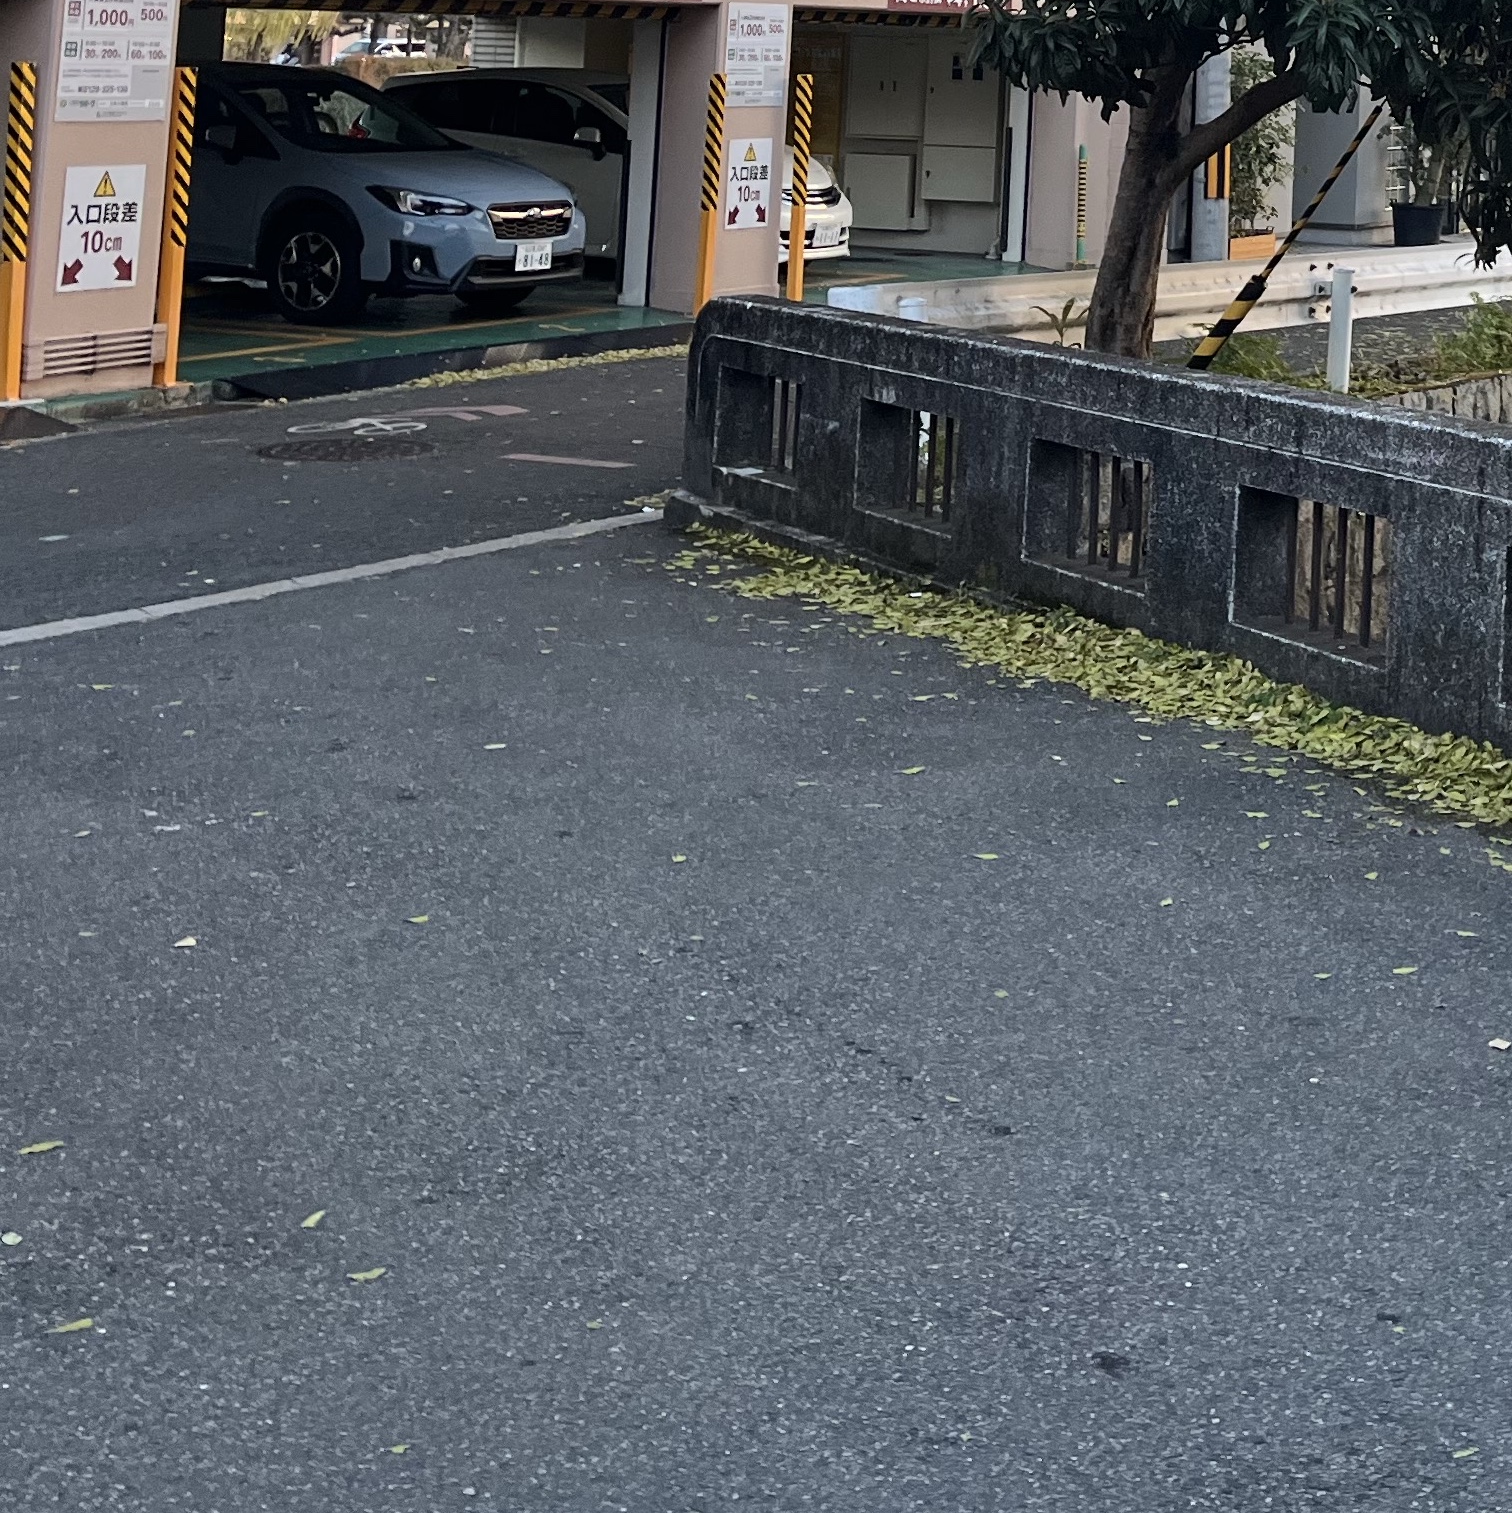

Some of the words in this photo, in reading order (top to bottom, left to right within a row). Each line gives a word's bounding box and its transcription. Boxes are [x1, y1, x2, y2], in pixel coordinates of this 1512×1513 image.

[729, 165, 768, 182] 入口段差
[67, 202, 138, 226] 入口段差
[80, 230, 122, 254] 10cm
